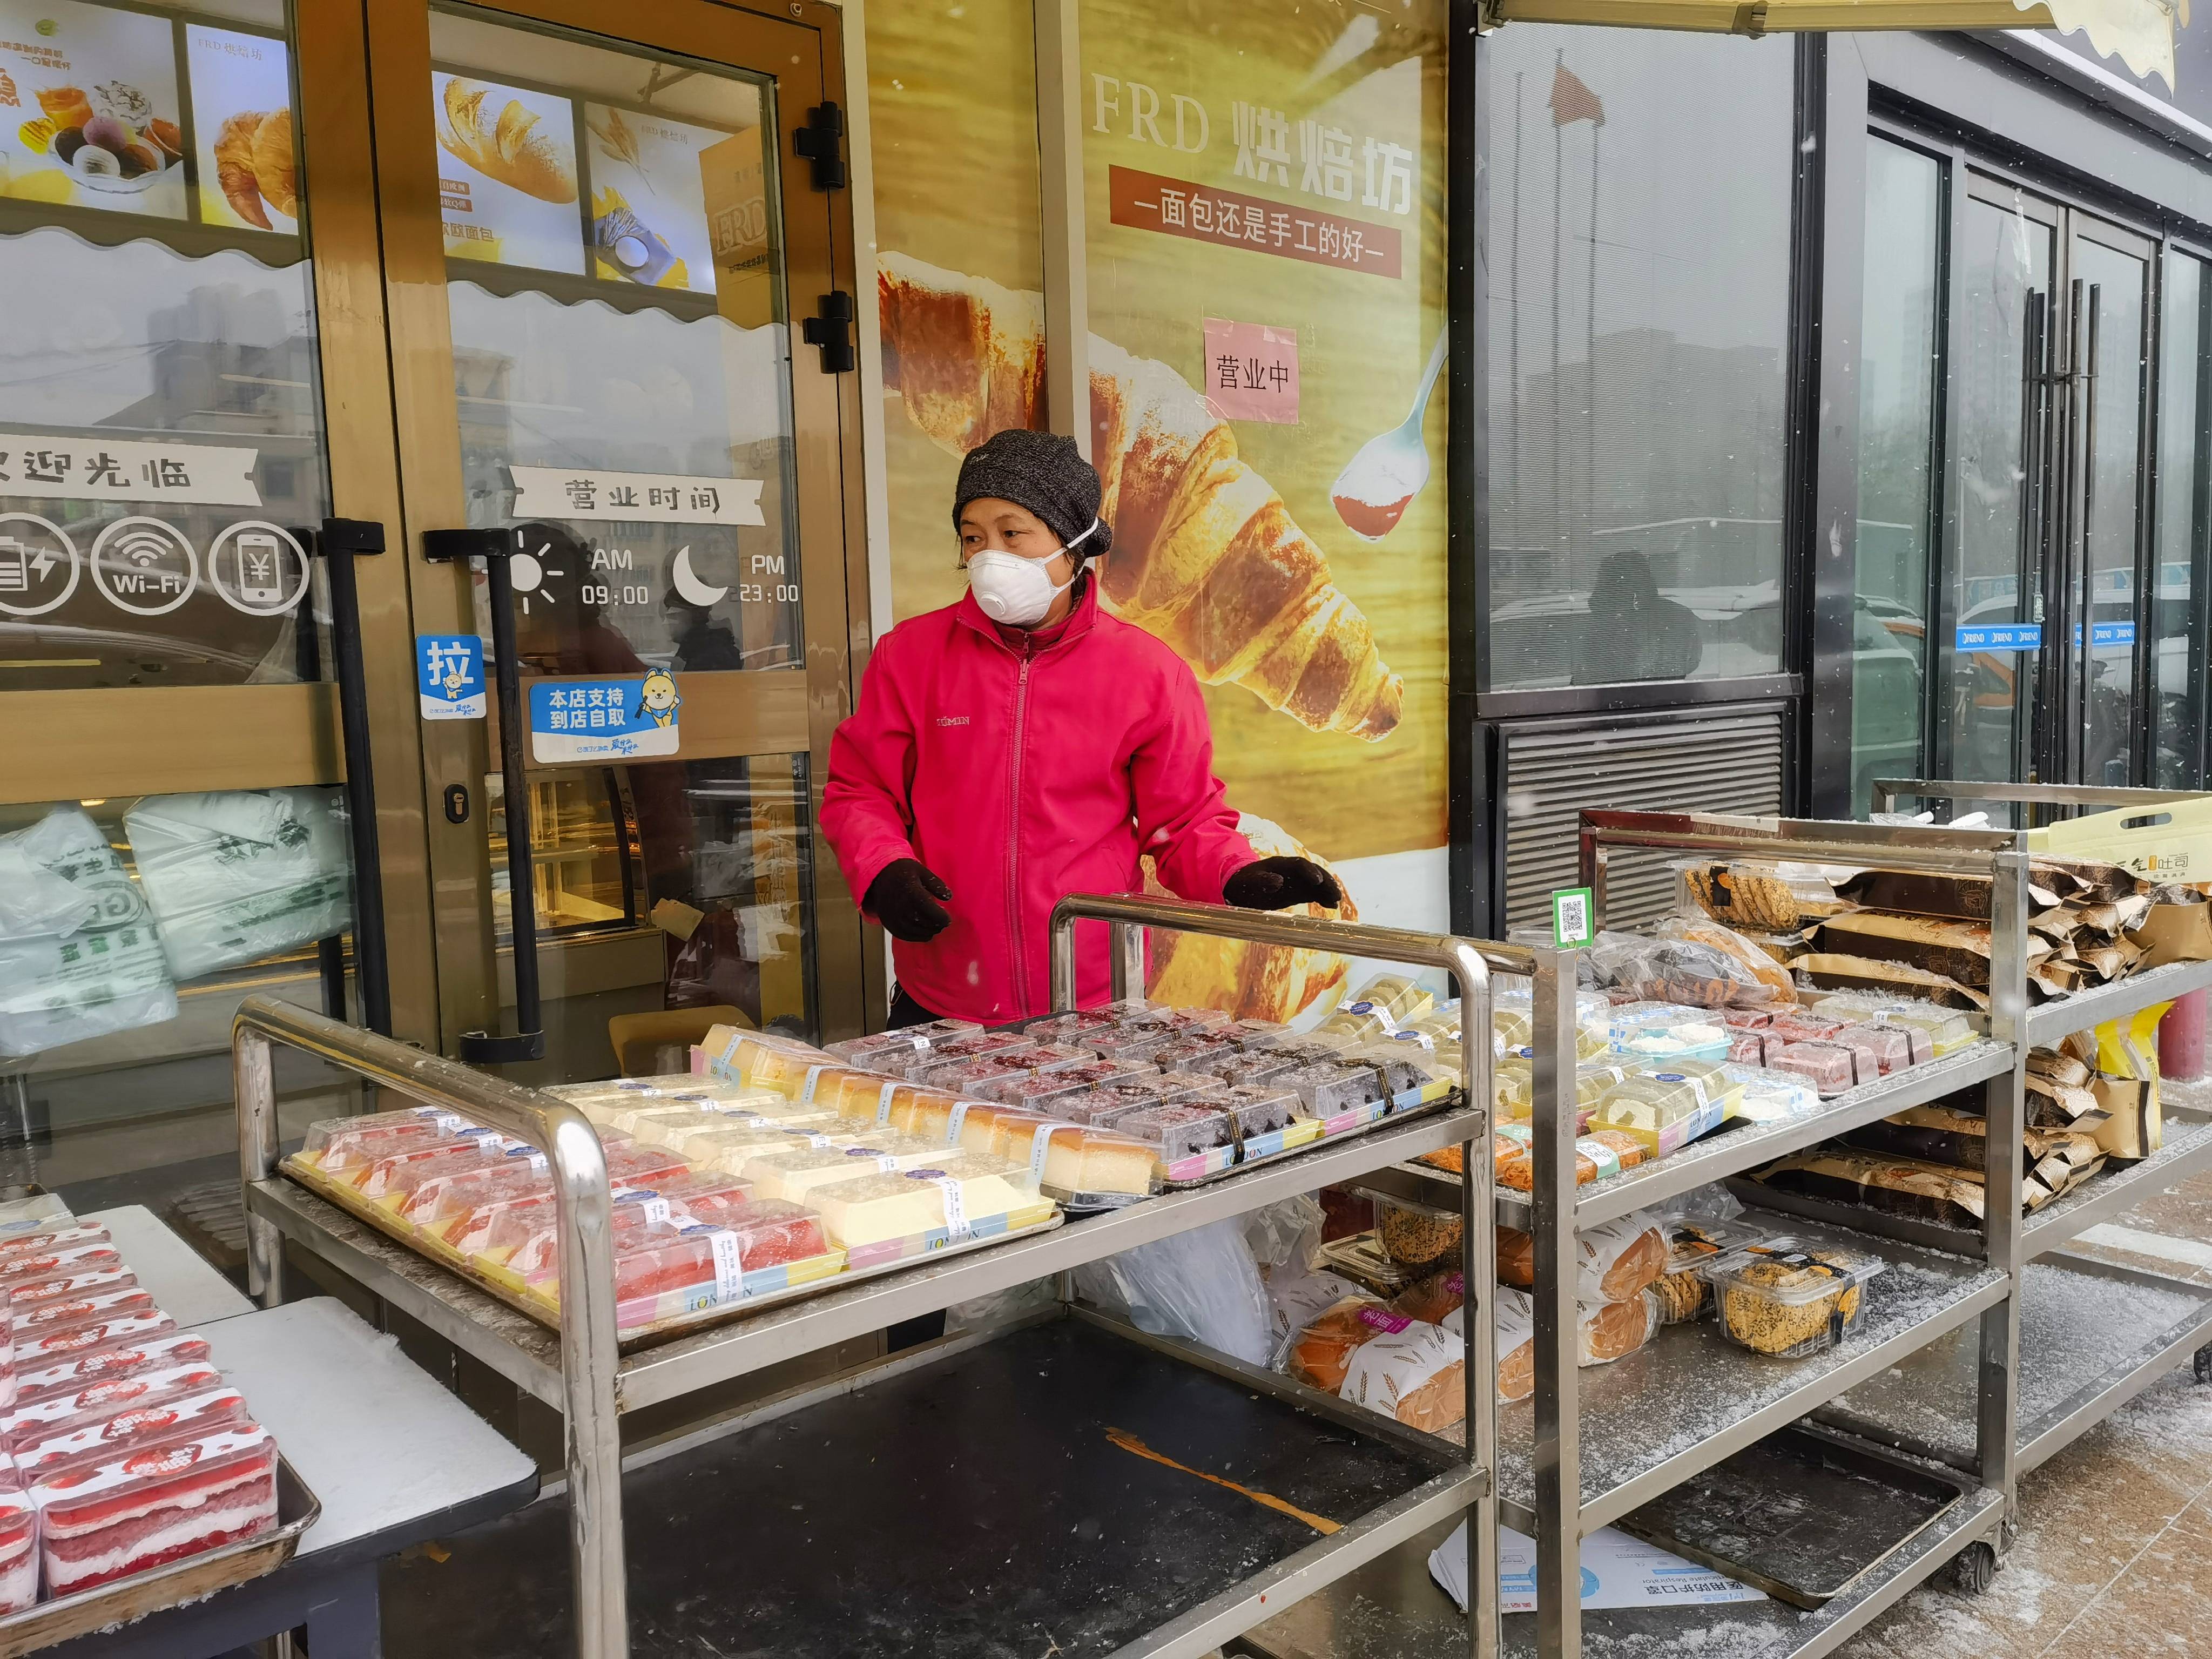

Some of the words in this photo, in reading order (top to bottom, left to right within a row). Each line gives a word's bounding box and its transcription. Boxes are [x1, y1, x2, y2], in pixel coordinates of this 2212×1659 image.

[1091, 73, 1209, 153] FRD
[1231, 100, 1413, 215] 烘焙坊
[1216, 355, 1289, 393] 营业中
[565, 478, 720, 514] 营业时间
[591, 549, 632, 571] AM
[751, 555, 785, 575] PM
[112, 574, 180, 594] Wi-Fi
[582, 585, 649, 604] 09:00
[739, 584, 799, 603] 23:00
[427, 641, 474, 686] 拉
[549, 687, 625, 708] 本店支持
[549, 708, 626, 730] 到店自取
[710, 1065, 733, 1081] LOON
[1373, 1102, 1405, 1121] LOON
[1225, 1147, 1263, 1165] LOON
[929, 1229, 981, 1250] LONN
[690, 1285, 753, 1311] LONN
[1644, 1581, 1744, 1595] 医用防护口罩
